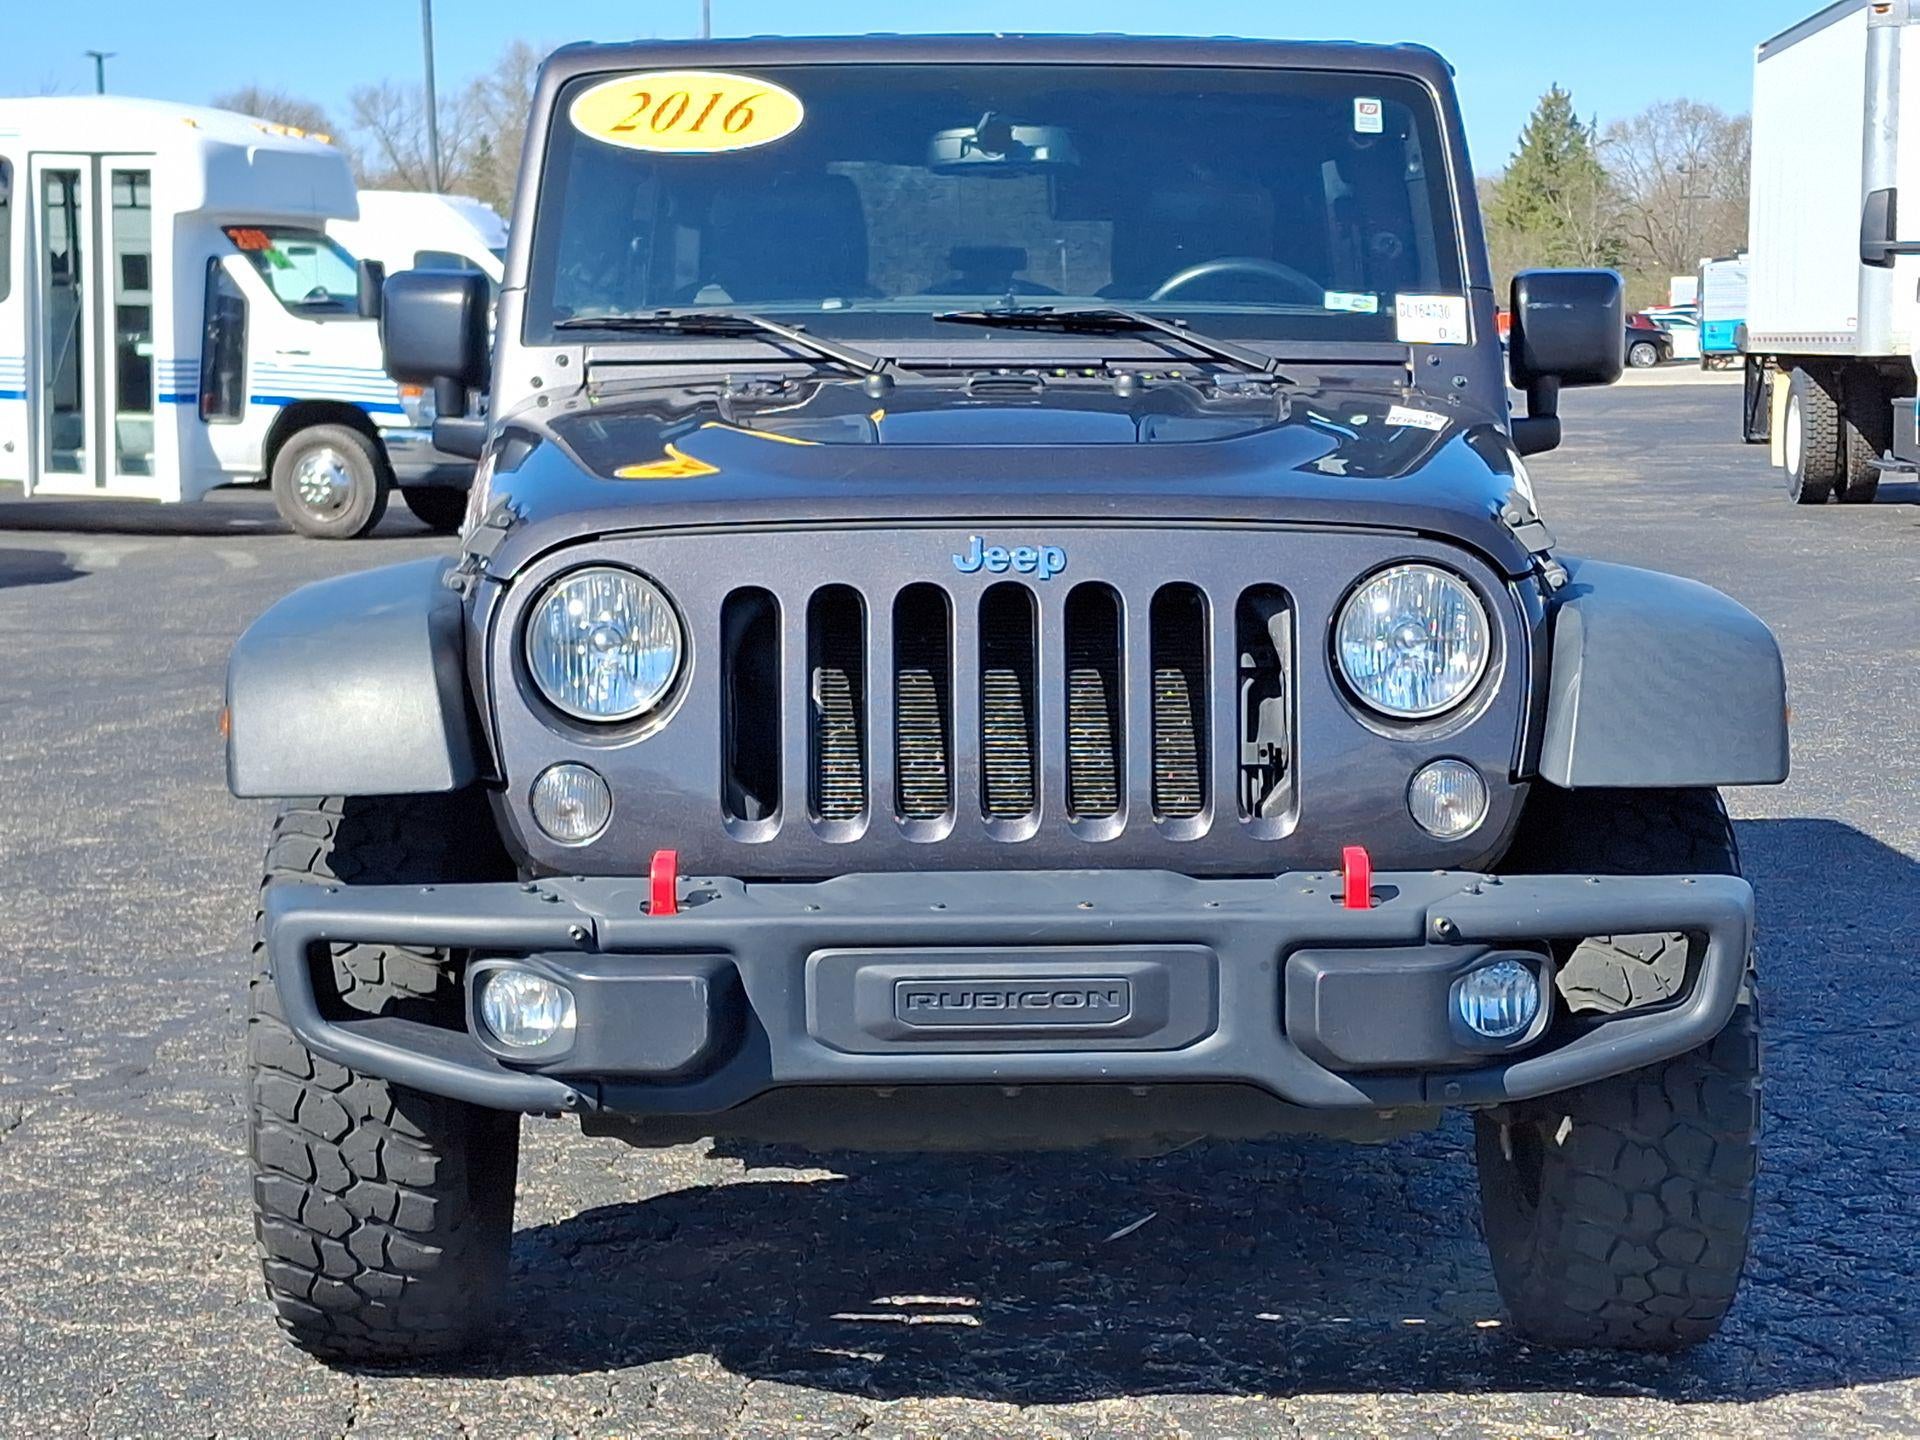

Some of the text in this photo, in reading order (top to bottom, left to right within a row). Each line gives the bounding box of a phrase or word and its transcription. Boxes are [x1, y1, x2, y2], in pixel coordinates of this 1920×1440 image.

[610, 91, 769, 133] 2016
[952, 536, 1067, 580] Jeep
[907, 990, 1121, 1010] RUBICON
